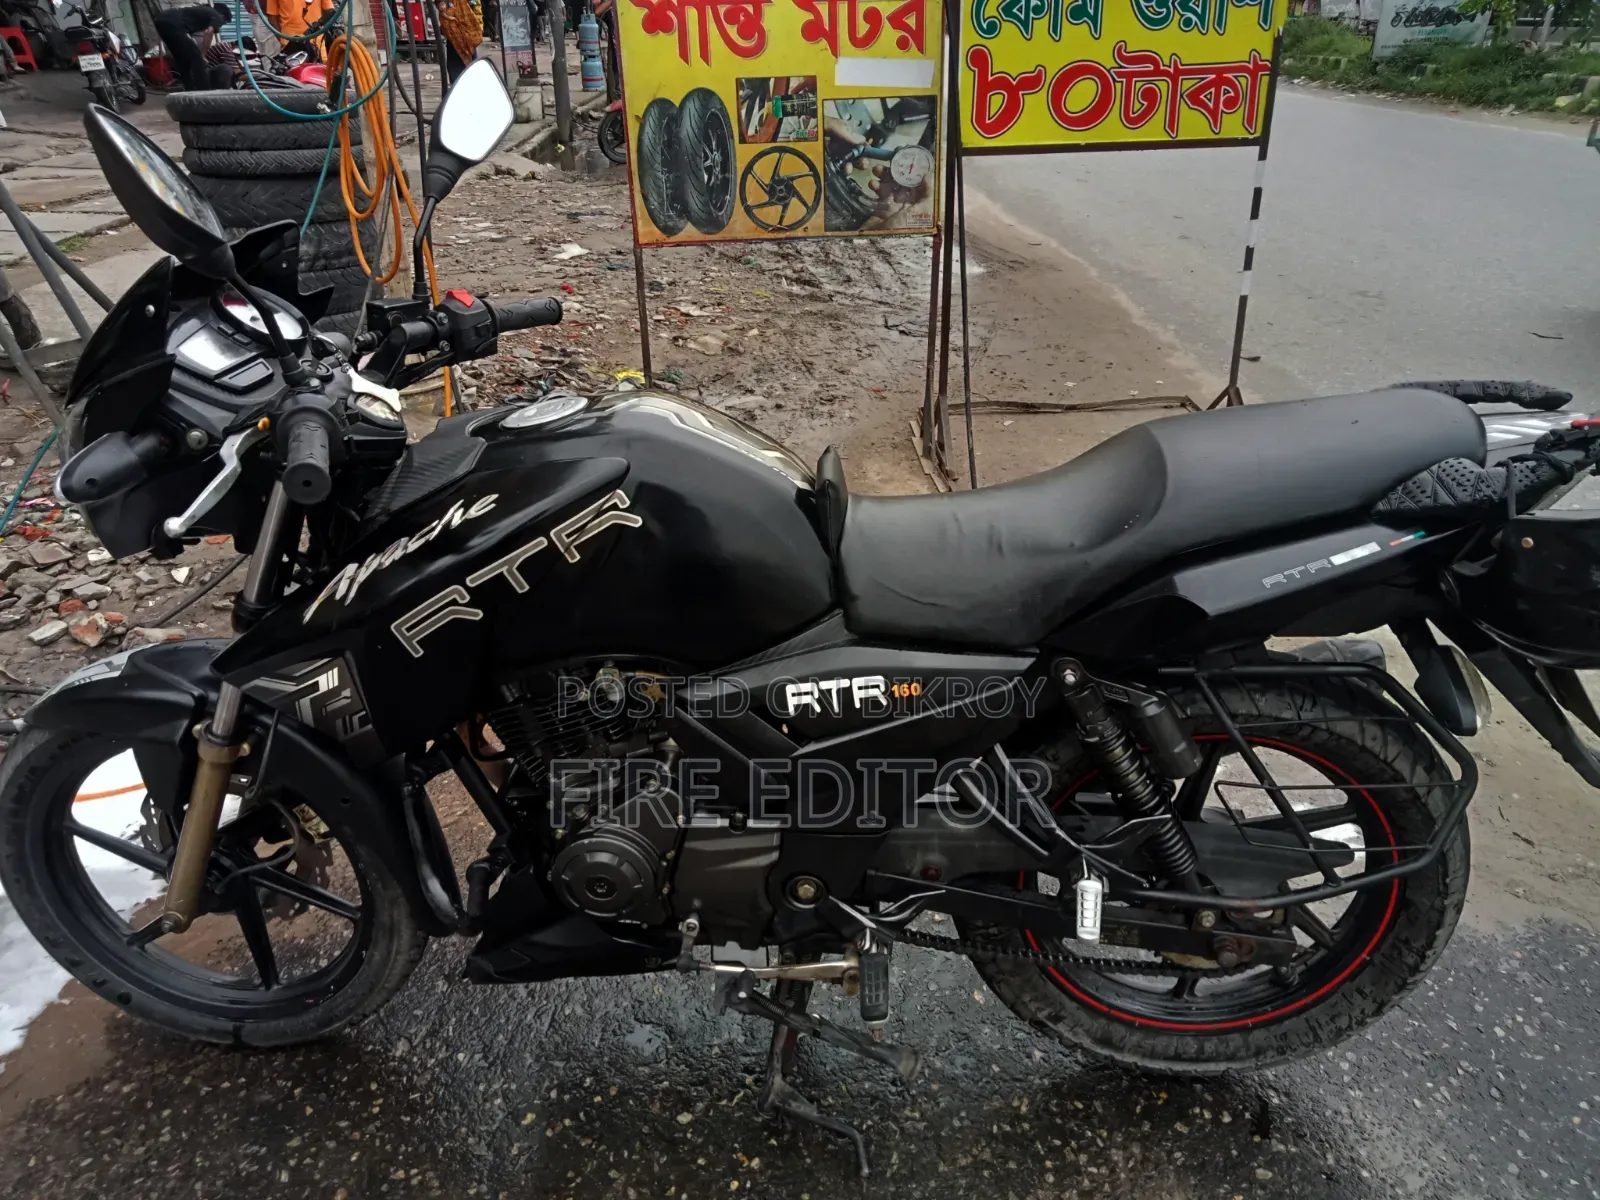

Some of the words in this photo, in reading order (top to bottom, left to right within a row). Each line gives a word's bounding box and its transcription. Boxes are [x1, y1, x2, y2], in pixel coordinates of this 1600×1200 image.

[793, 0, 926, 59] মটর
[302, 493, 499, 624] Apache
[391, 489, 643, 658] RTR
[1262, 558, 1331, 588] RTR
[785, 675, 888, 717] RTR
[891, 682, 921, 698] 160
